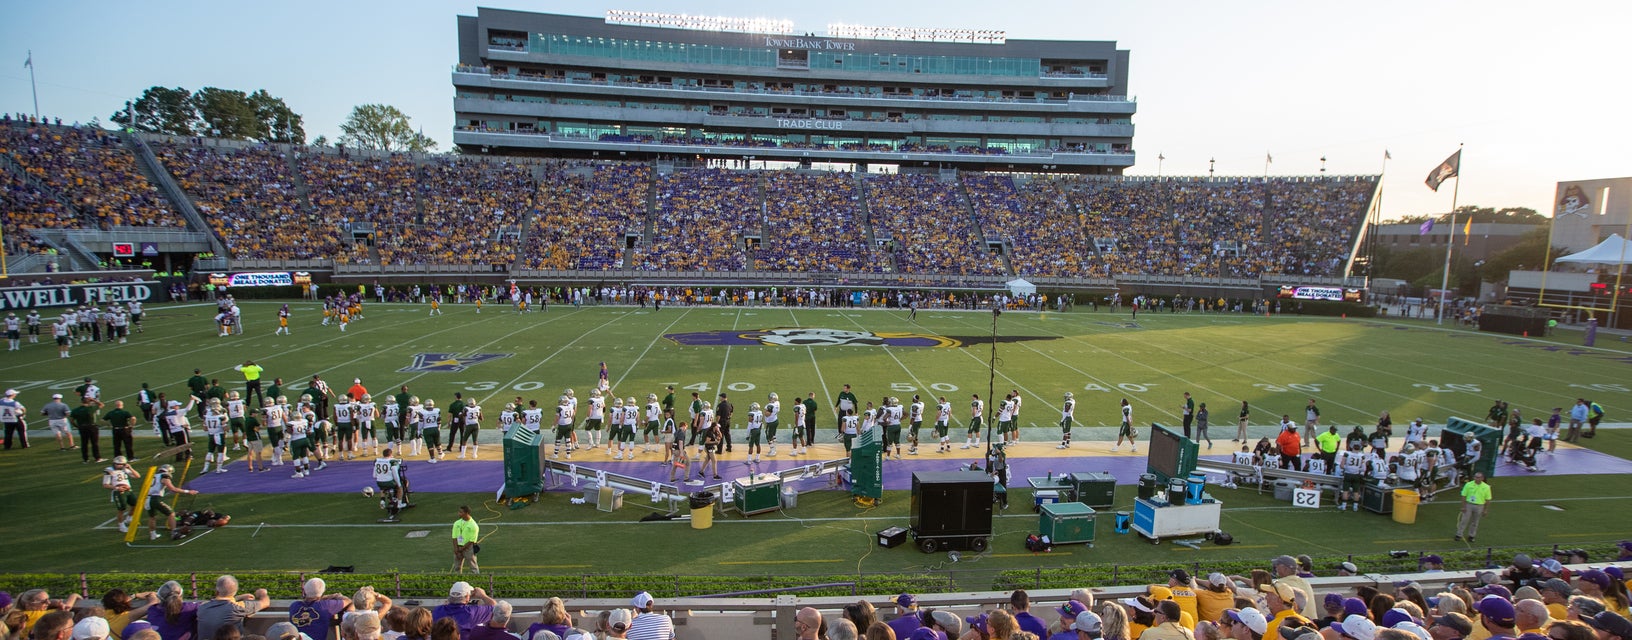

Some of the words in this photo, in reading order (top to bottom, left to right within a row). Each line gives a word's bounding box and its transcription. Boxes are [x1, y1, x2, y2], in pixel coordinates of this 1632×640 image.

[776, 118, 812, 128] TRADE
[815, 120, 842, 129] CLUB
[338, 409, 348, 417] 10
[362, 408, 374, 417] 87
[208, 420, 217, 428] 17
[1239, 457, 1250, 465] 90
[1350, 458, 1360, 466] 31
[376, 464, 388, 474] 89
[1312, 462, 1322, 470] 91
